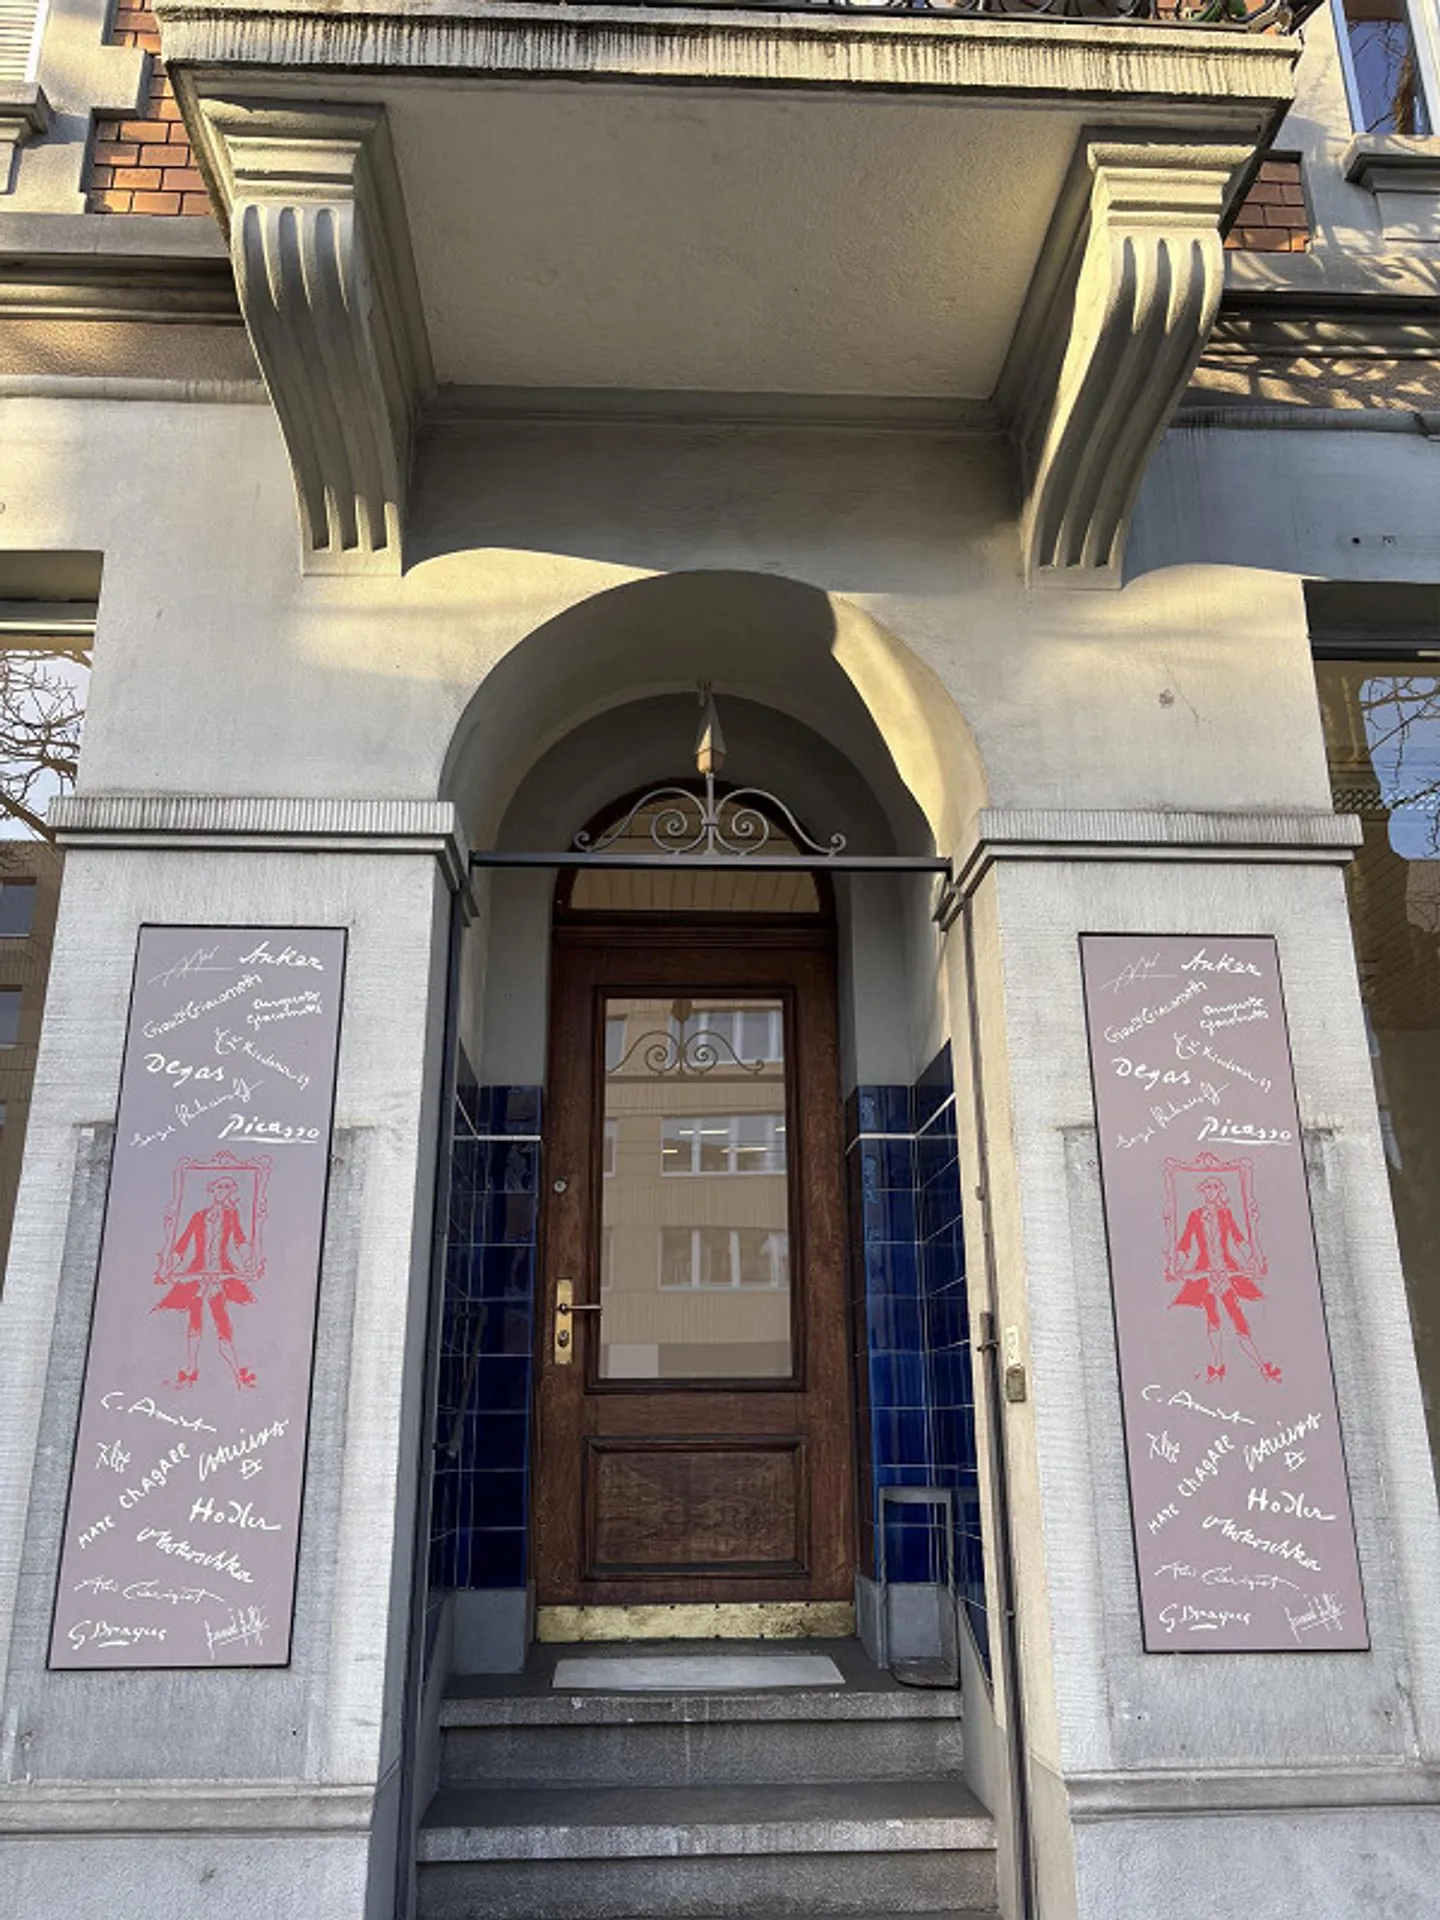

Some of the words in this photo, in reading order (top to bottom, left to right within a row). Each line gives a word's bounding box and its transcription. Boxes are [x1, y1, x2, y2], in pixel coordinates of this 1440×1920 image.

[240, 941, 323, 970] Anker
[1182, 948, 1261, 977] Anker
[145, 1051, 226, 1088] Degas
[1113, 1056, 1190, 1091] Degas
[219, 1114, 319, 1143] Picasso
[1198, 1116, 1291, 1145] Picasso
[190, 1497, 280, 1530] Hodler
[1249, 1487, 1335, 1520] Hodler
